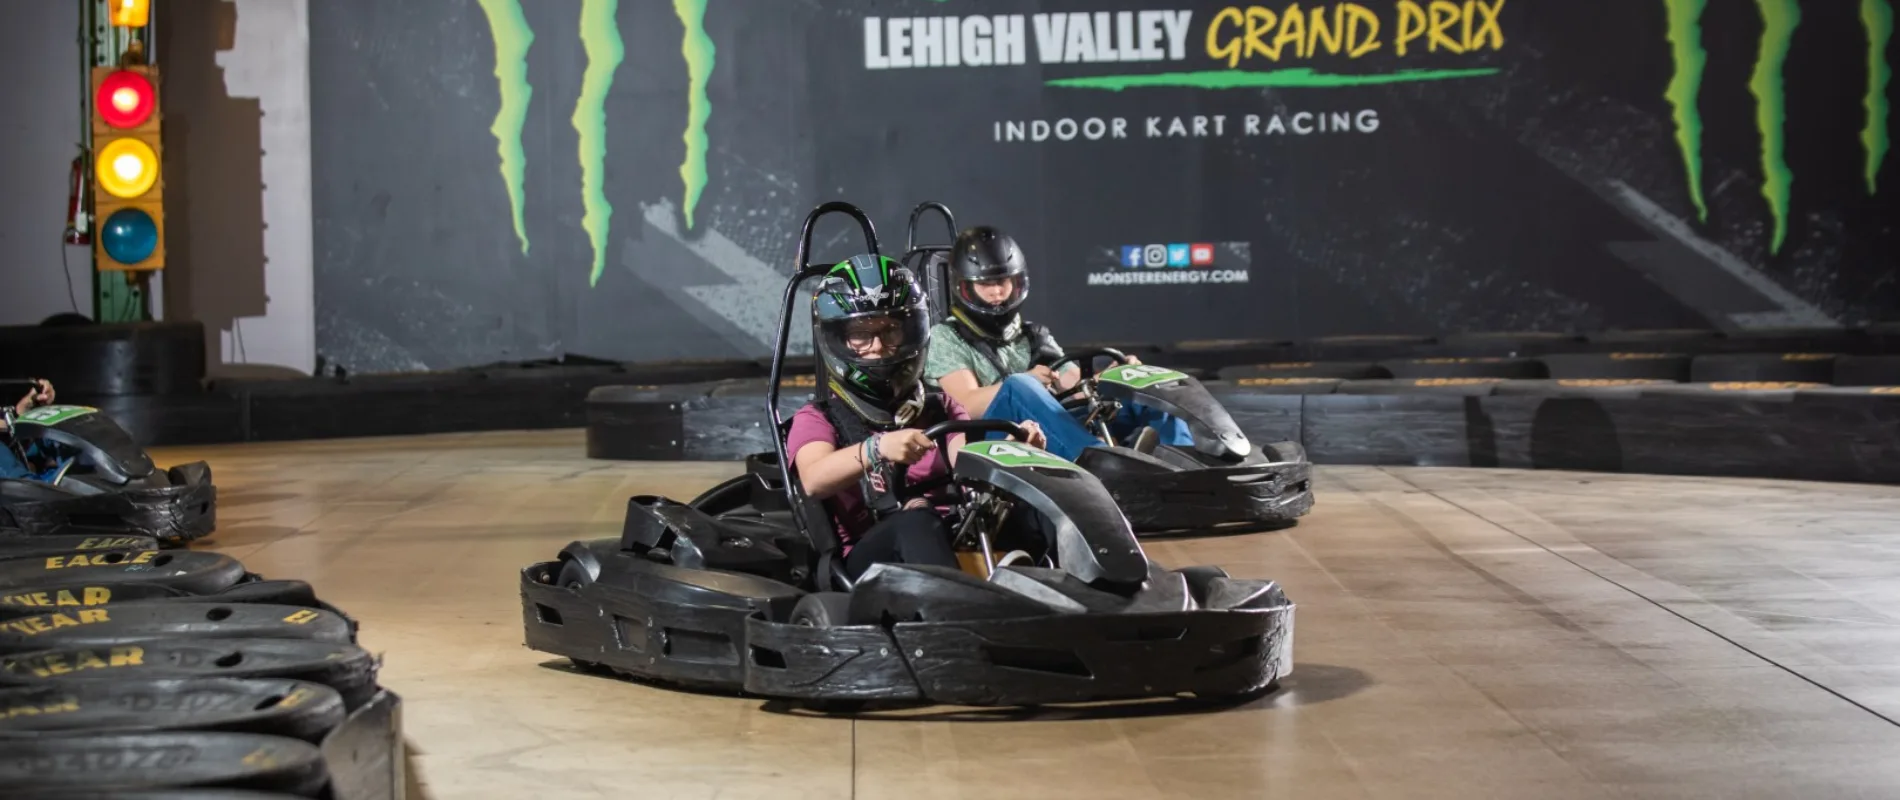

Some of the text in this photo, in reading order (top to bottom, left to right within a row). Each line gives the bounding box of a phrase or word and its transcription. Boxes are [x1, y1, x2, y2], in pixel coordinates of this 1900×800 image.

[864, 0, 1505, 69] LEHIGH VALLEY GRAND PRIX
[994, 109, 1381, 142] INDOOR KART RACING
[1087, 270, 1249, 286] MONSTERENERGY.COM
